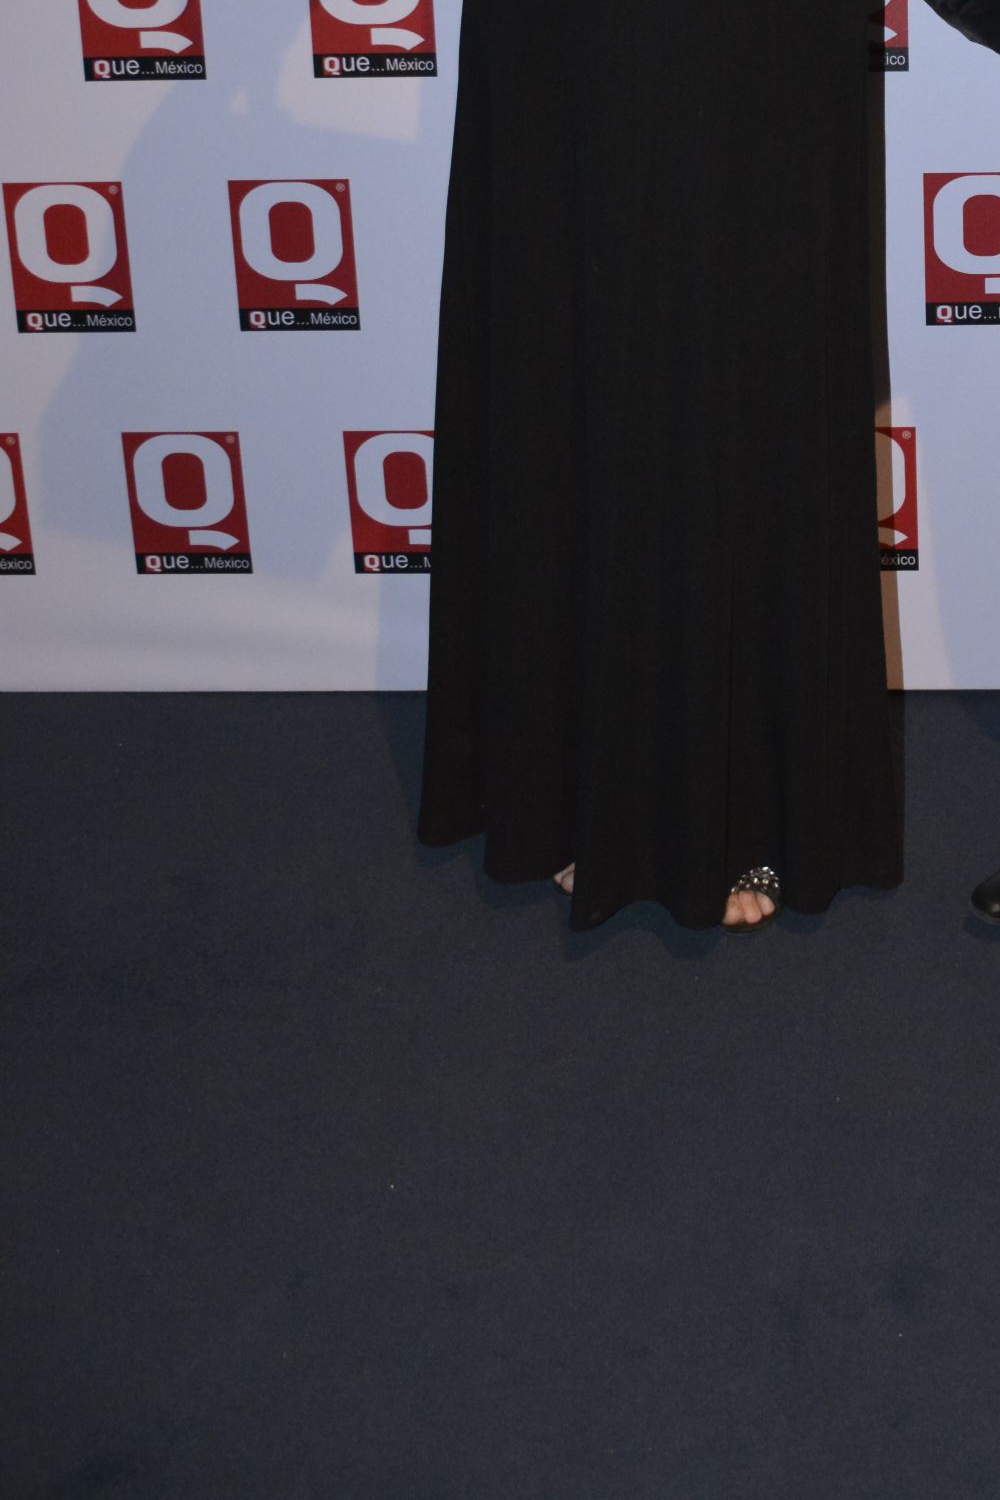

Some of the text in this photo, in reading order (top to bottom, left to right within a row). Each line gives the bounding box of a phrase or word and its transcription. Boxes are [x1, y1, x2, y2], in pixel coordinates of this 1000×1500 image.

[14, 185, 122, 306] Q
[239, 182, 347, 305] Q
[133, 434, 239, 550] Q
